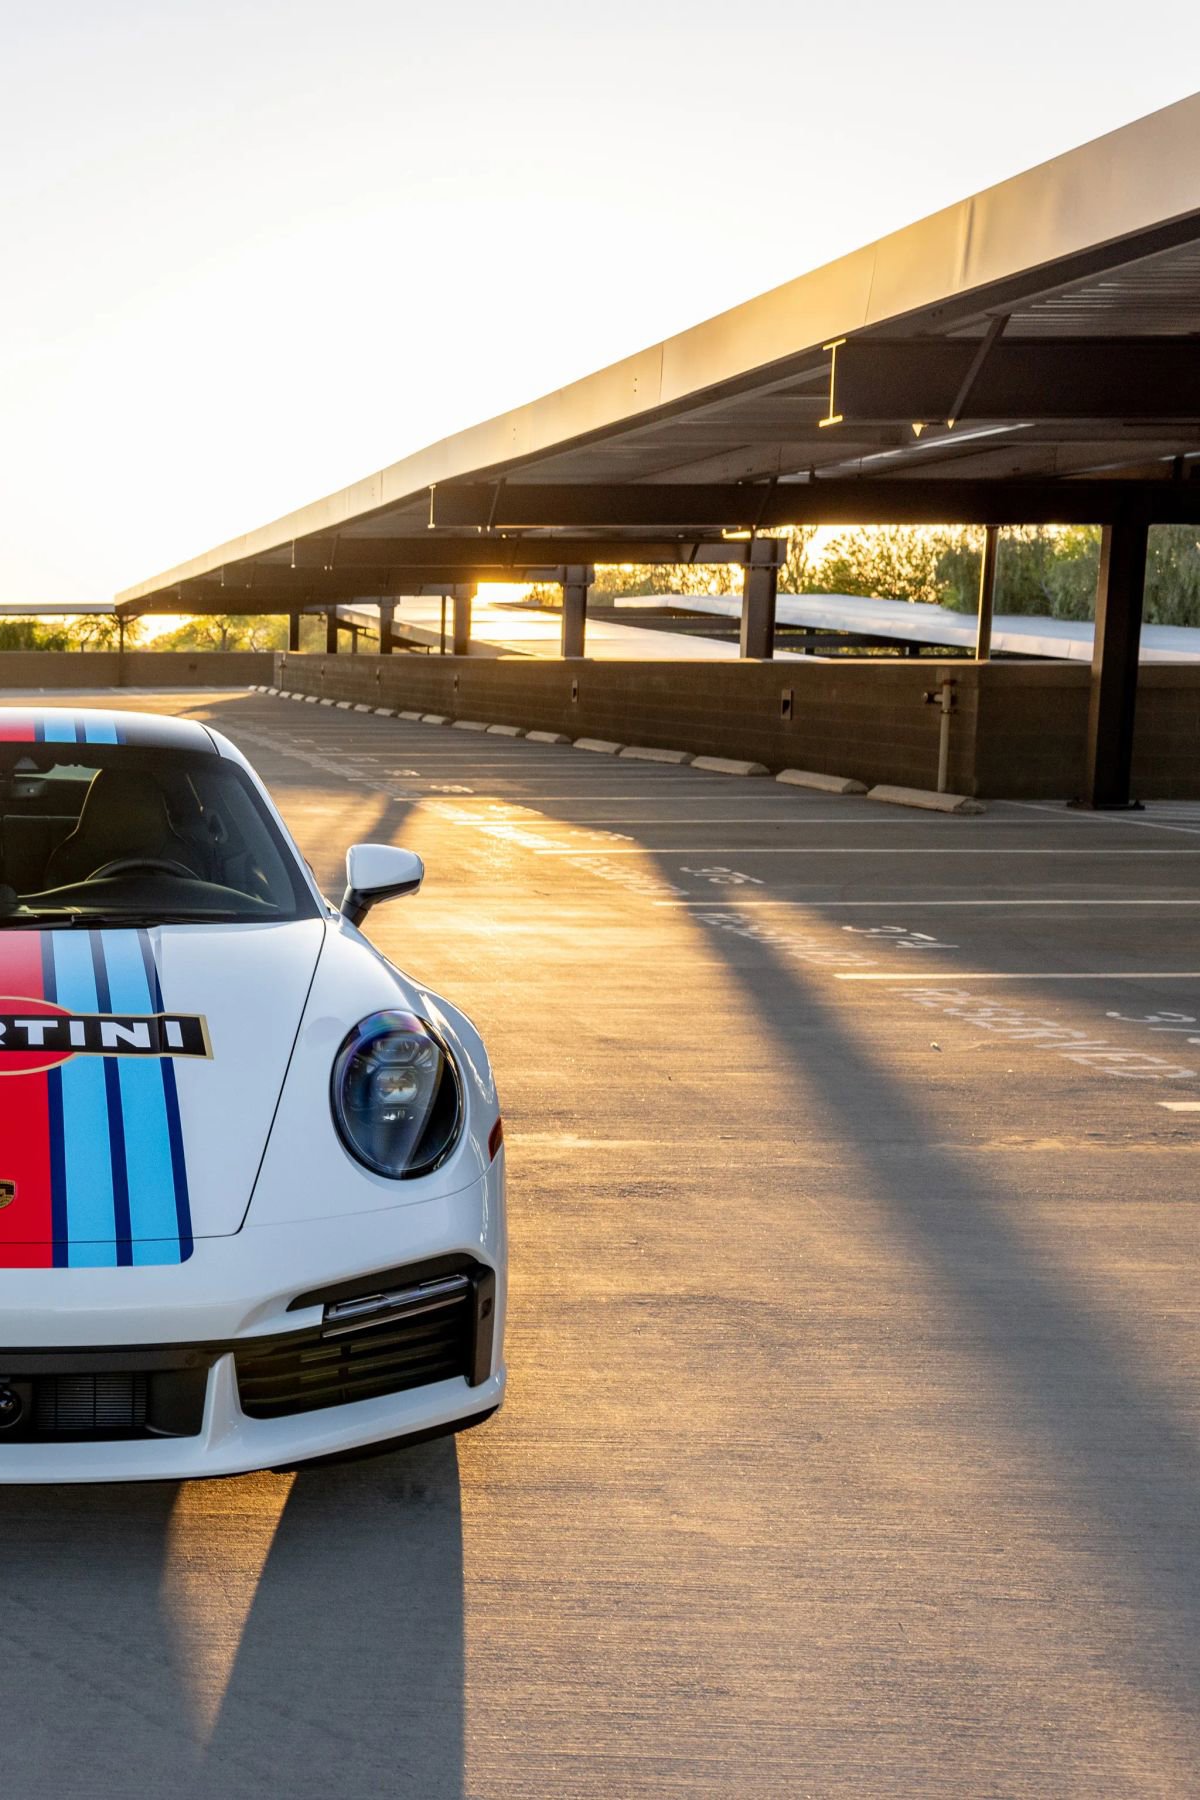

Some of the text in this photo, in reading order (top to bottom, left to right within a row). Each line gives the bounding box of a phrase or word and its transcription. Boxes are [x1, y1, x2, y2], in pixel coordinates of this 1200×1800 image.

[679, 866, 765, 884] 375
[688, 913, 878, 967] RESERVED
[842, 925, 959, 949] 374
[886, 988, 1197, 1079] RESERVED
